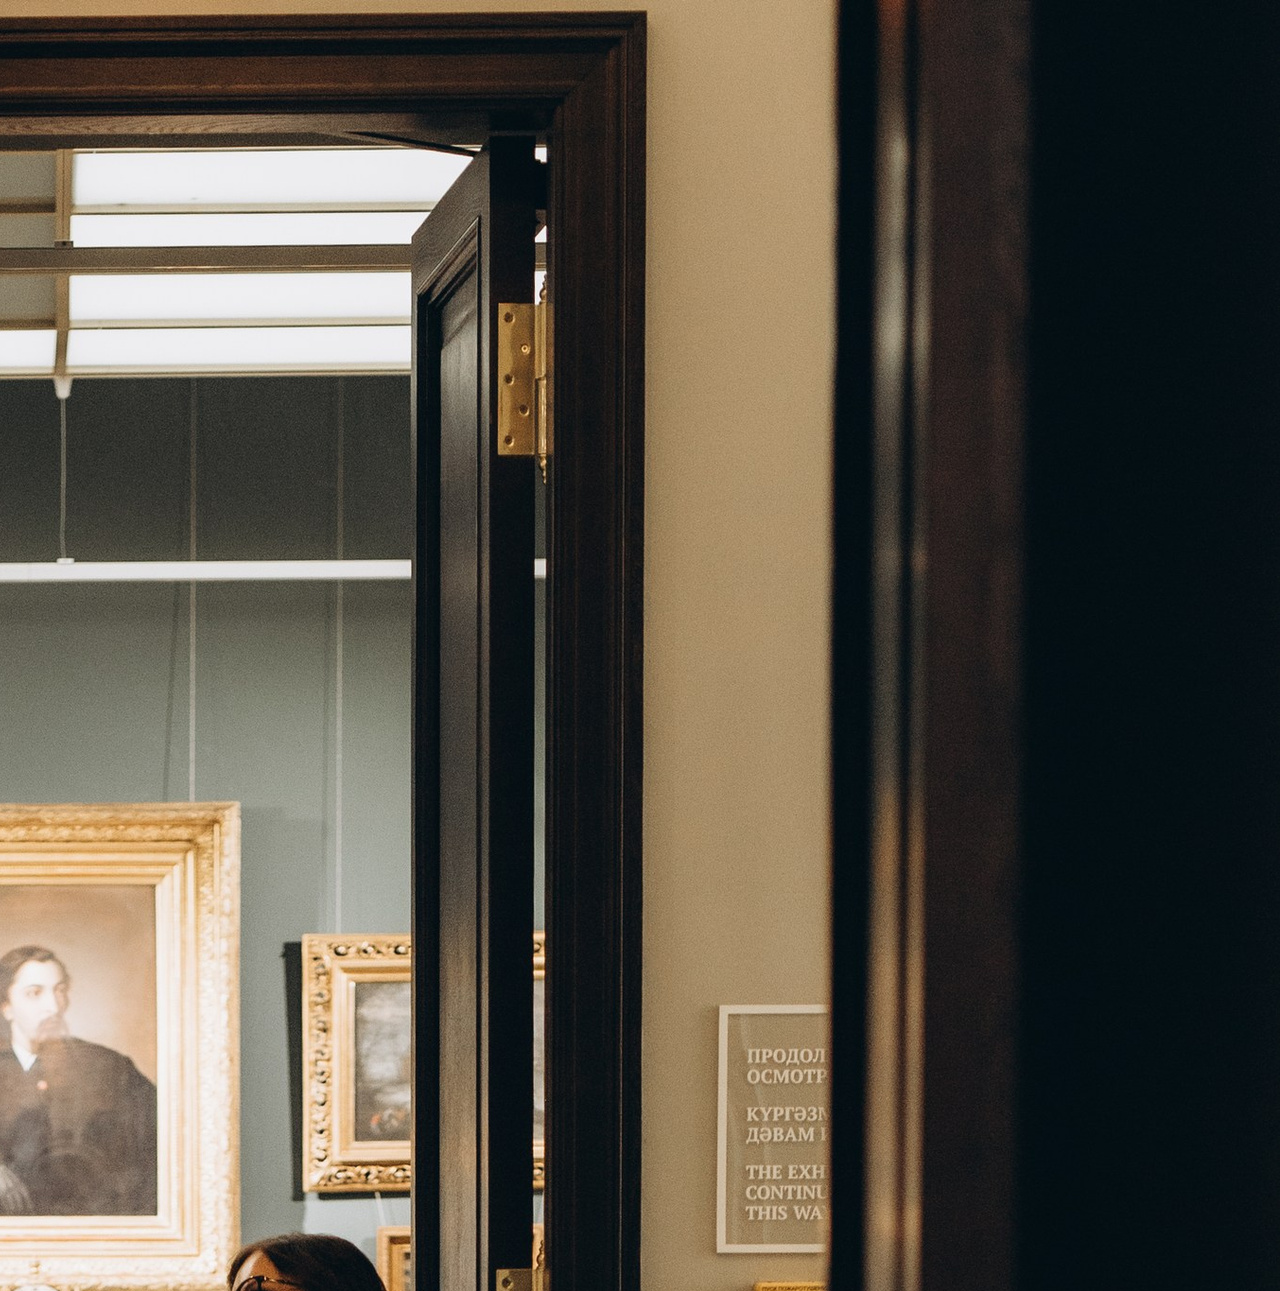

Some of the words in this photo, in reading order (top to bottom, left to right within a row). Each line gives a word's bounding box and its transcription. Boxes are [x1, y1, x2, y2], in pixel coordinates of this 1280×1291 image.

[747, 1069, 828, 1085] ОСМОТР
[745, 1127, 815, 1145] ДӘВАМ
[745, 1164, 783, 1180] THE
[788, 1164, 826, 1180] EXH
[745, 1205, 788, 1220] THIS
